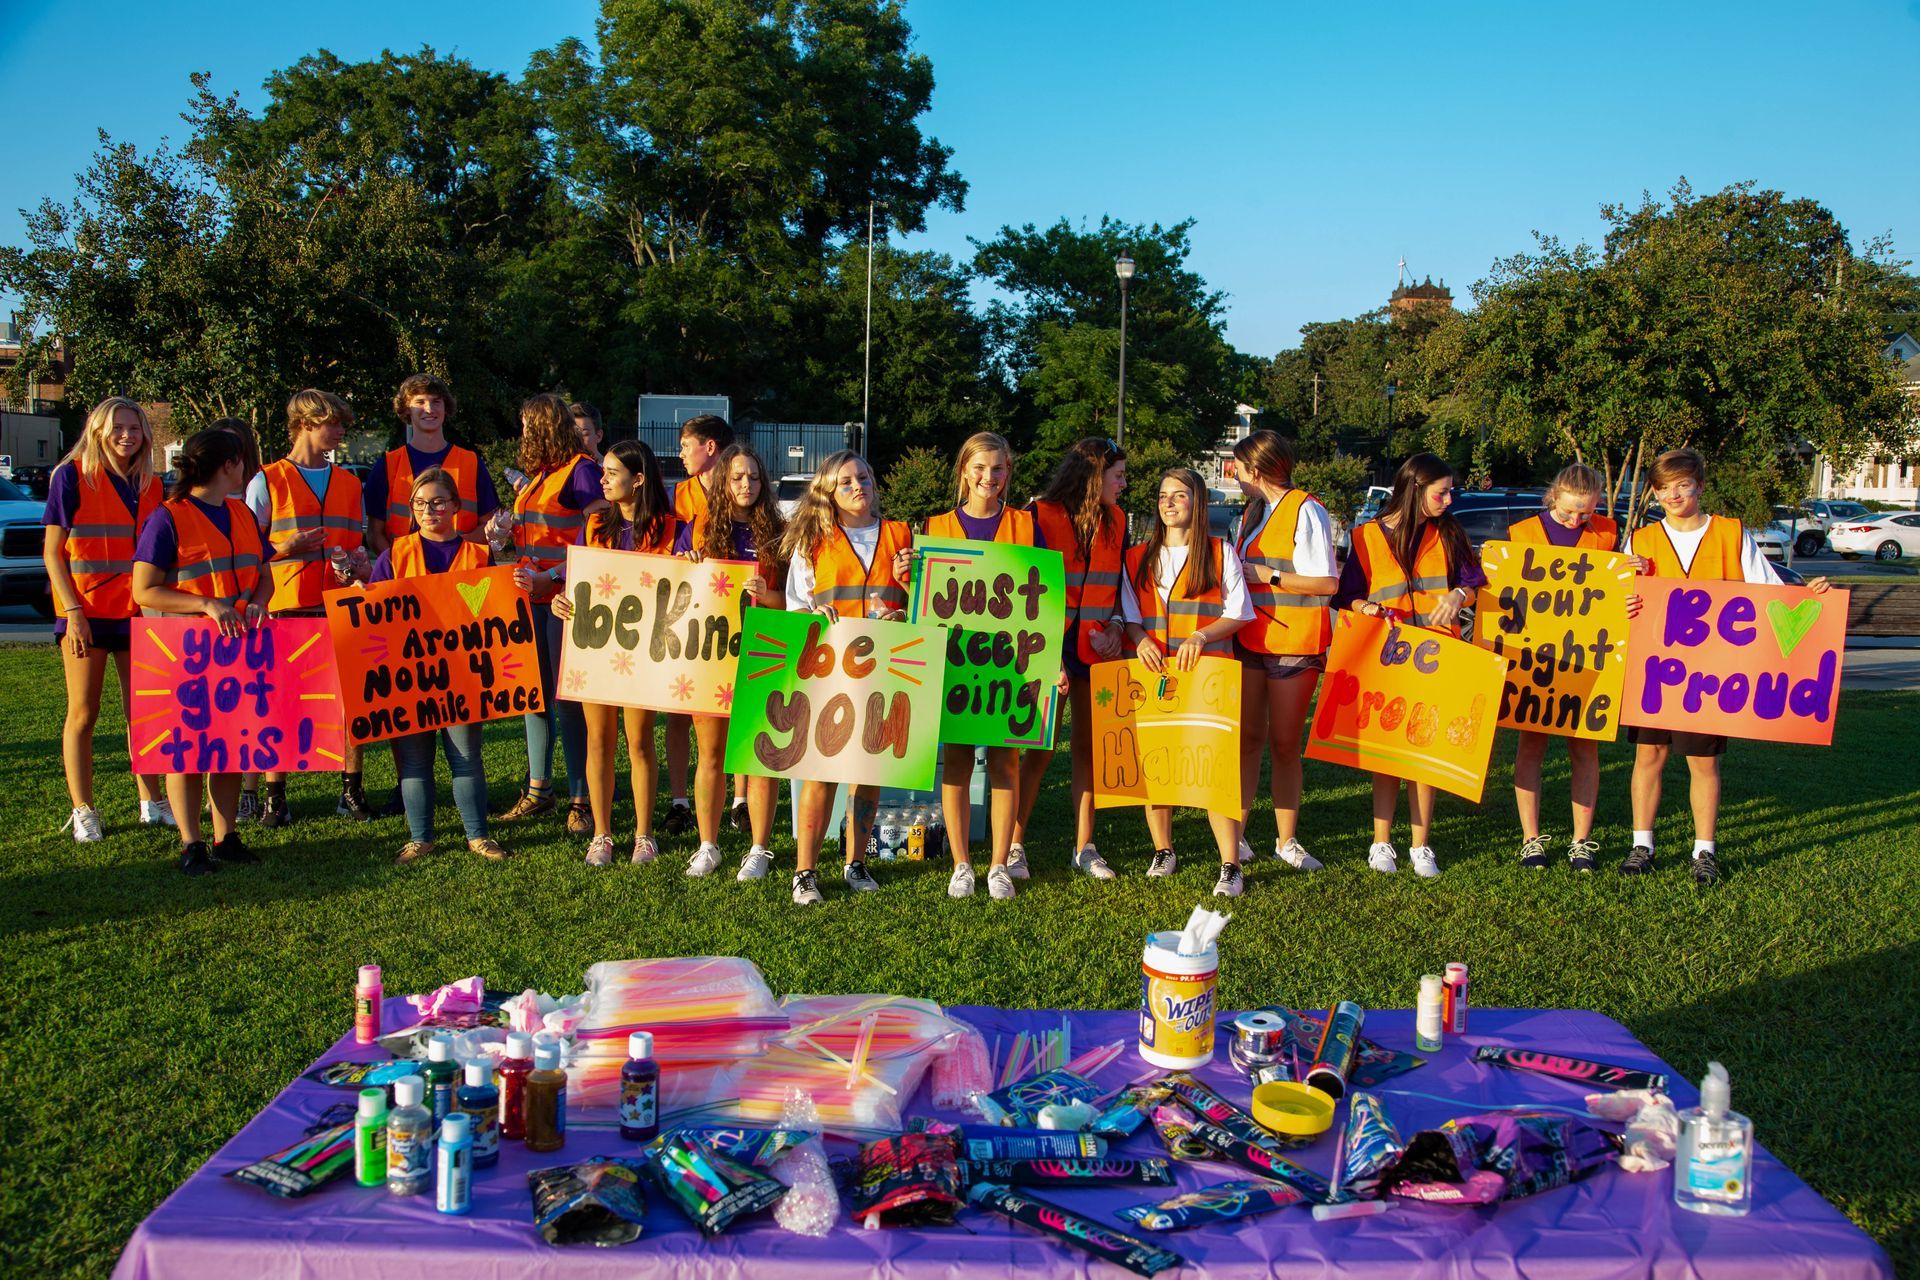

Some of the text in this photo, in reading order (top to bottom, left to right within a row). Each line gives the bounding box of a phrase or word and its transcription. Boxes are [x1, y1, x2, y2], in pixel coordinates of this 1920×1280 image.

[932, 565, 1048, 620] just
[1521, 547, 1595, 585] Let
[336, 595, 421, 628] Turn
[402, 597, 533, 659] Around
[572, 581, 643, 650] be
[1498, 586, 1606, 634] your
[1664, 587, 1757, 648] Be
[183, 627, 275, 675] you
[469, 650, 494, 689] 4
[796, 620, 877, 680] be
[1380, 626, 1440, 674] be
[176, 671, 275, 731] got
[351, 706, 410, 740] one
[480, 685, 540, 720] race
[946, 673, 1042, 737] oing
[1115, 666, 1180, 718] be
[754, 689, 911, 772] you
[1165, 986, 1215, 1019] WIPE
